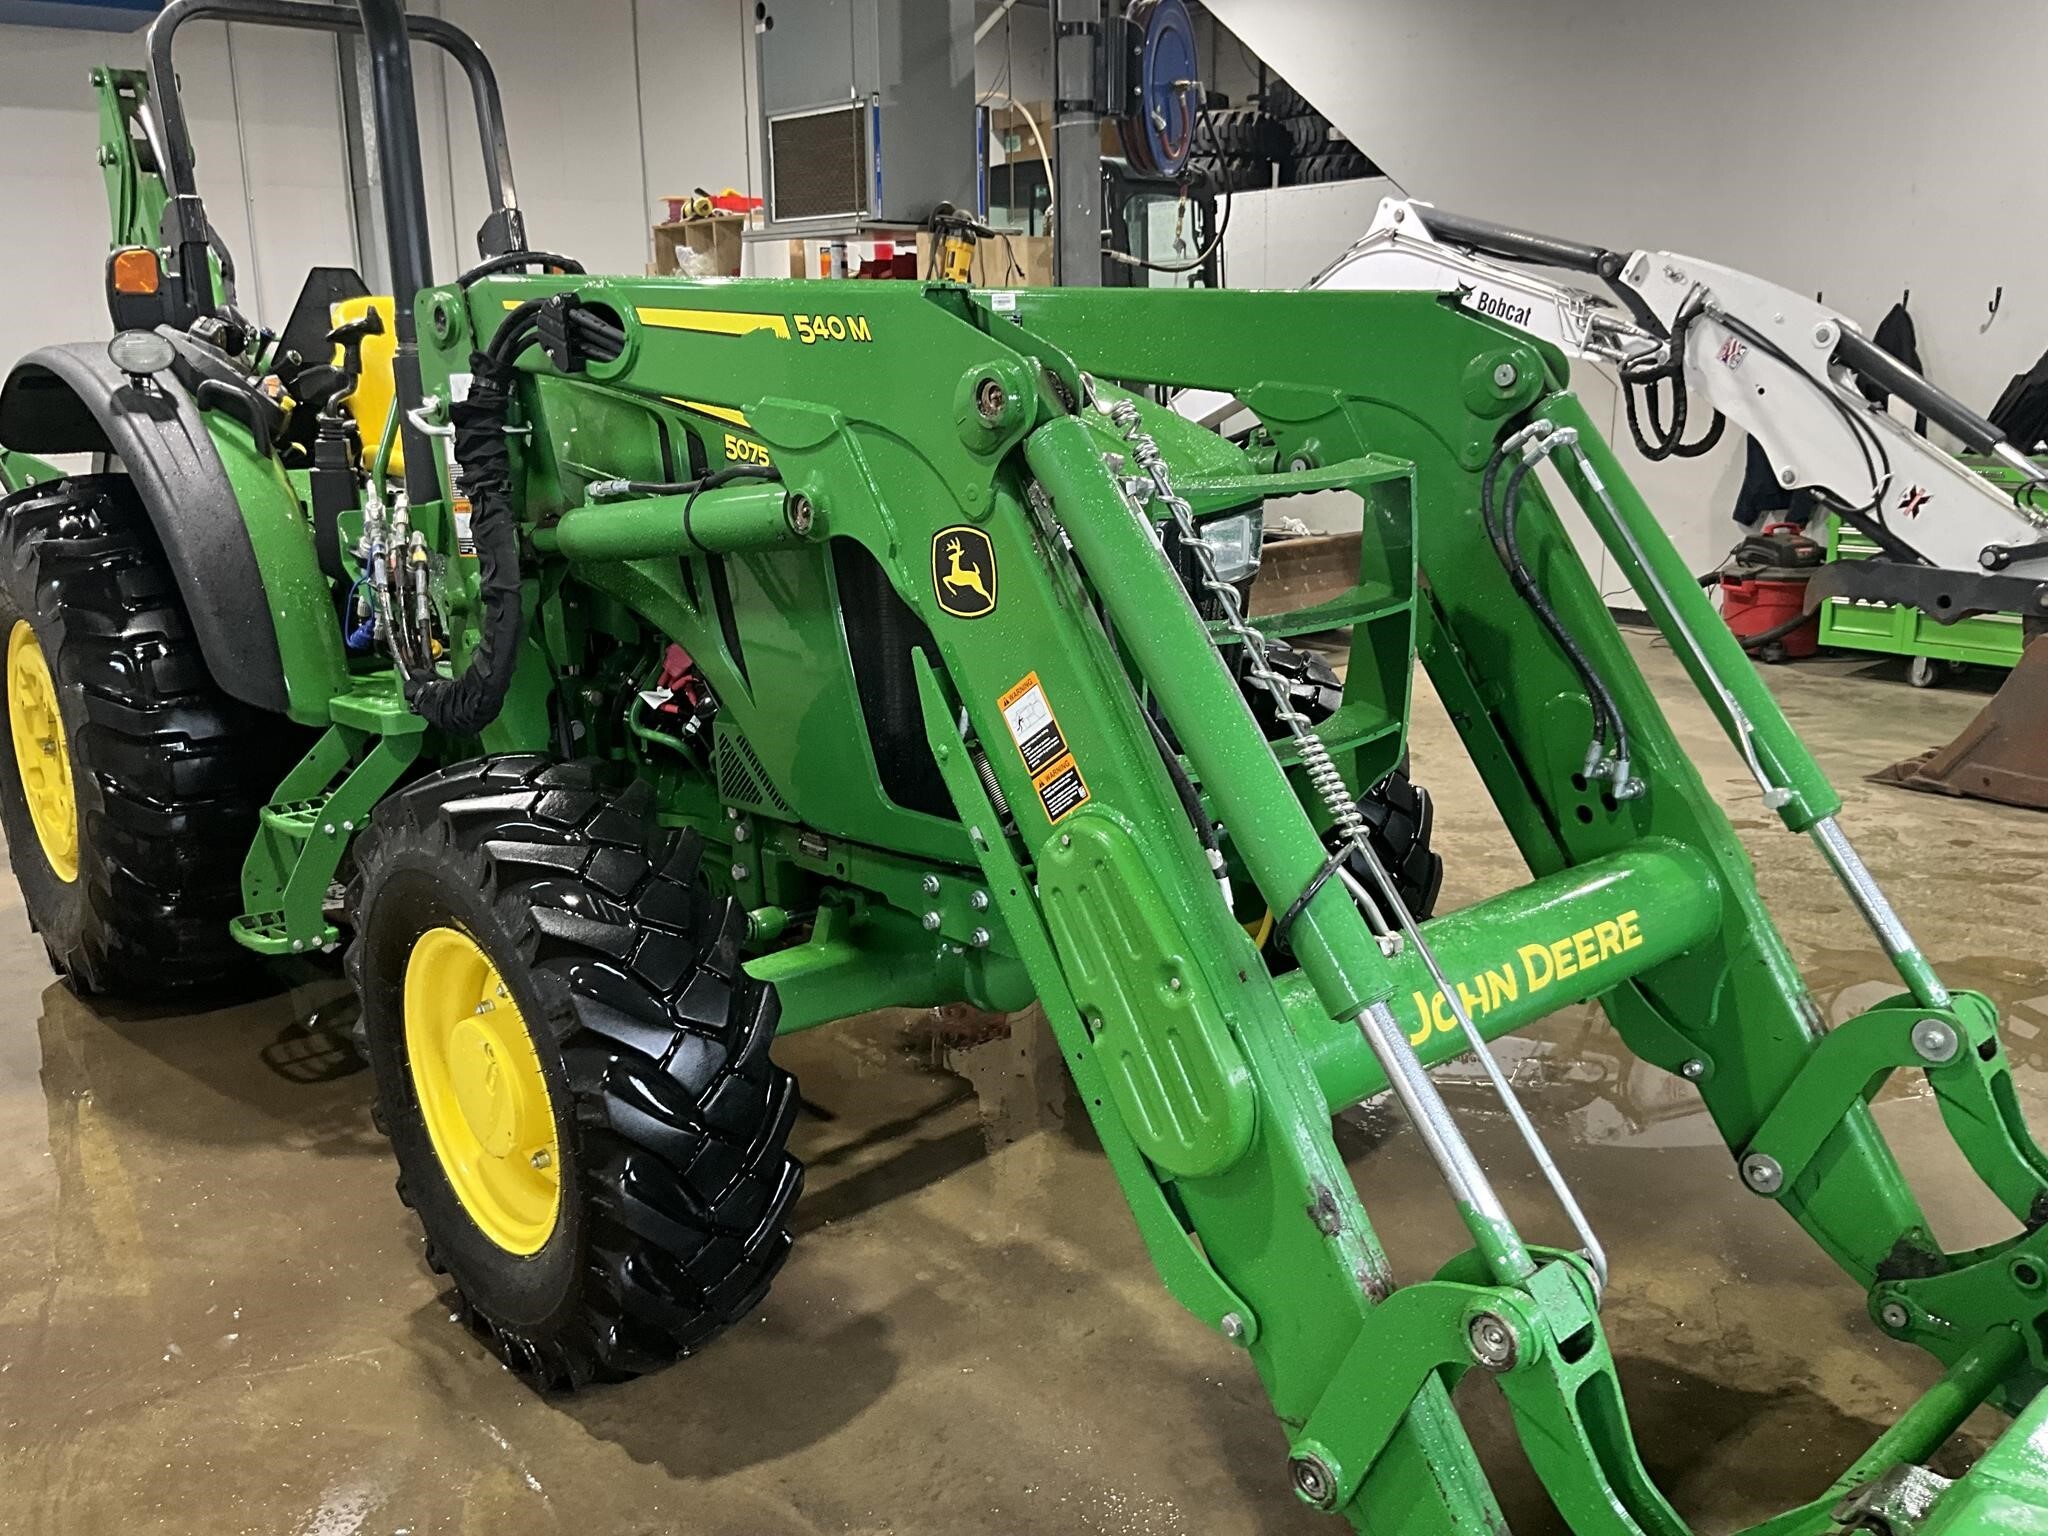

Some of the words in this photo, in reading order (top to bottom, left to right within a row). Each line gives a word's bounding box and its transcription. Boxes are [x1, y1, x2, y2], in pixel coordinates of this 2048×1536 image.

[1477, 291, 1531, 327] Bobcat
[792, 313, 847, 345] 540
[845, 314, 873, 343] M
[724, 433, 770, 467] 5075
[1009, 678, 1033, 701] WARNING
[1045, 760, 1070, 782] WARNING
[1410, 962, 1519, 1047] JOHN
[1517, 909, 1643, 993] DEERE
